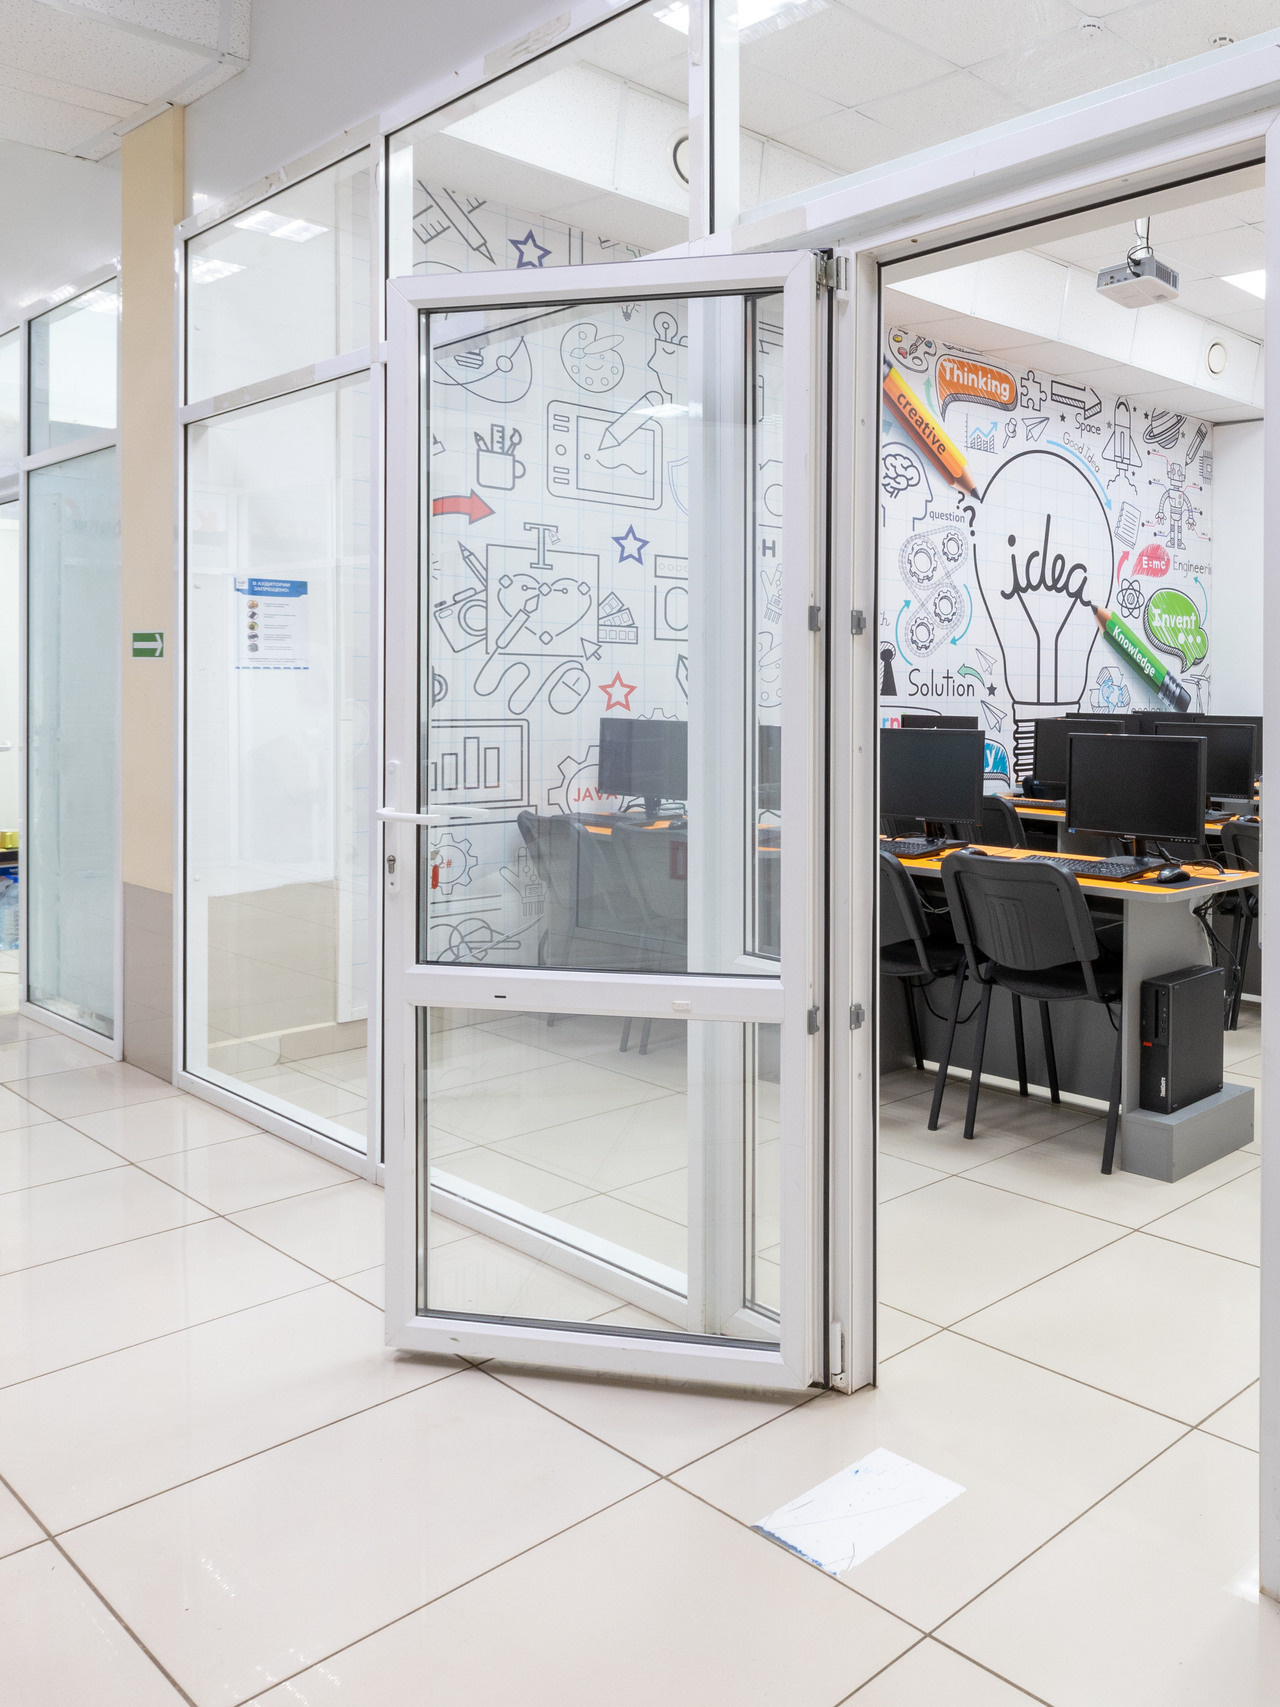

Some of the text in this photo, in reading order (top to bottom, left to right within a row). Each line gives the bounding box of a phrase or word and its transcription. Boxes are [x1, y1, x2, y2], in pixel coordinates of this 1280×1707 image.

[943, 361, 1009, 401] Thinking
[897, 392, 947, 457] creative
[1075, 412, 1101, 439] Space
[1063, 431, 1101, 473] Good Idea
[929, 509, 965, 523] question
[1000, 513, 1091, 607] idea
[1152, 608, 1197, 630] Invent
[1112, 625, 1156, 678] Knowledge
[908, 668, 975, 697] Solution
